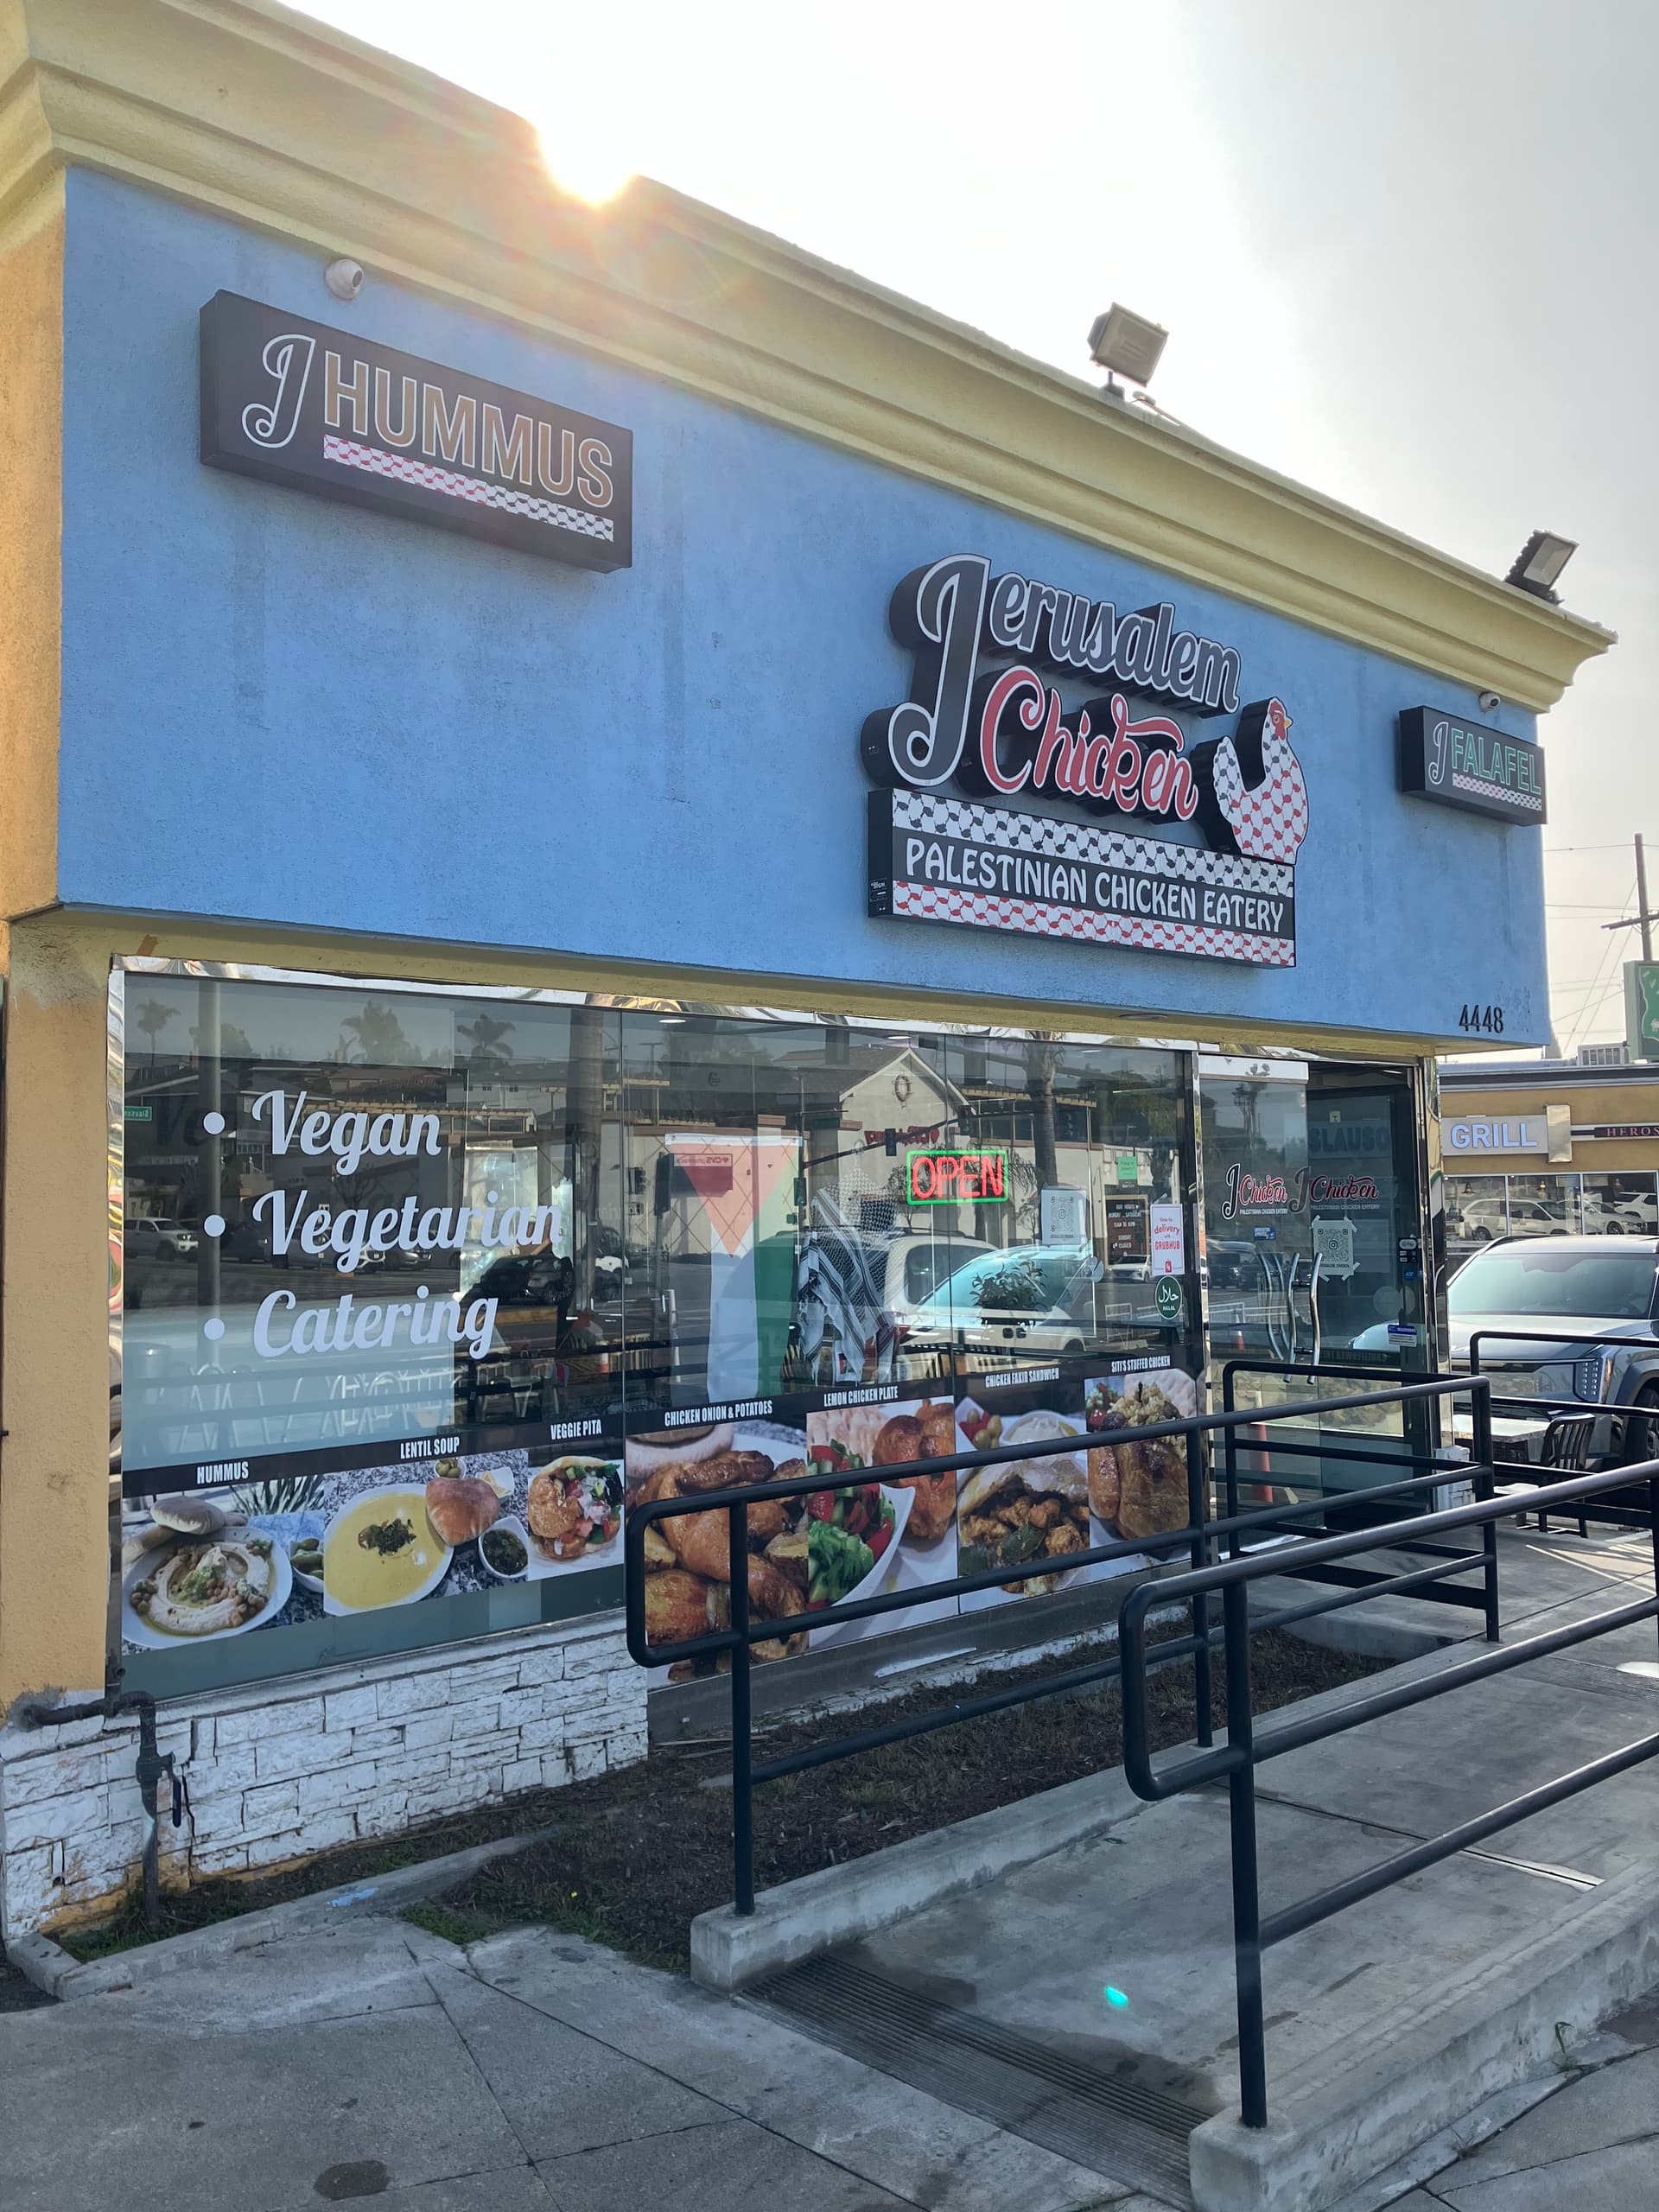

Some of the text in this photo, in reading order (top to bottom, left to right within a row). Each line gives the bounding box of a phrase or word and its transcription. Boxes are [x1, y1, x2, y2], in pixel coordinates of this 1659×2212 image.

[242, 334, 613, 507] J HUMMUS
[887, 553, 1242, 787] Jerusalem
[980, 664, 1199, 822] Chicken
[1428, 721, 1542, 795] J FALAFEL
[905, 837, 1285, 932] PALESTINIAN CHICKEN EATERY
[1459, 1004, 1503, 1034] 4448
[251, 1089, 442, 1176] Vegan
[1451, 1123, 1537, 1148] GRILL
[911, 1155, 1004, 1199] OPEN
[1222, 1163, 1287, 1219] J Chicken
[1311, 1174, 1379, 1202] Chicken
[252, 1189, 563, 1273] Vegetarian
[1154, 1224, 1180, 1235] delivery
[1155, 1241, 1180, 1250] GRUBHUB
[1158, 1285, 1179, 1303] حلال
[253, 1285, 499, 1360] Catering
[1127, 1357, 1148, 1370] STUFFED
[1148, 1355, 1171, 1369] CHICKEN
[985, 1373, 1011, 1388] CHICKEN
[1028, 1368, 1059, 1382] SANDWICH
[823, 1385, 899, 1408] LEMON CHICKEN PLATE
[664, 1400, 772, 1427] CHICKEN ONION & POTATOES
[550, 1419, 602, 1440] VEGGIE PITA
[400, 1436, 461, 1459] LENTIL SOUP
[196, 1462, 249, 1484] HUMMUS
